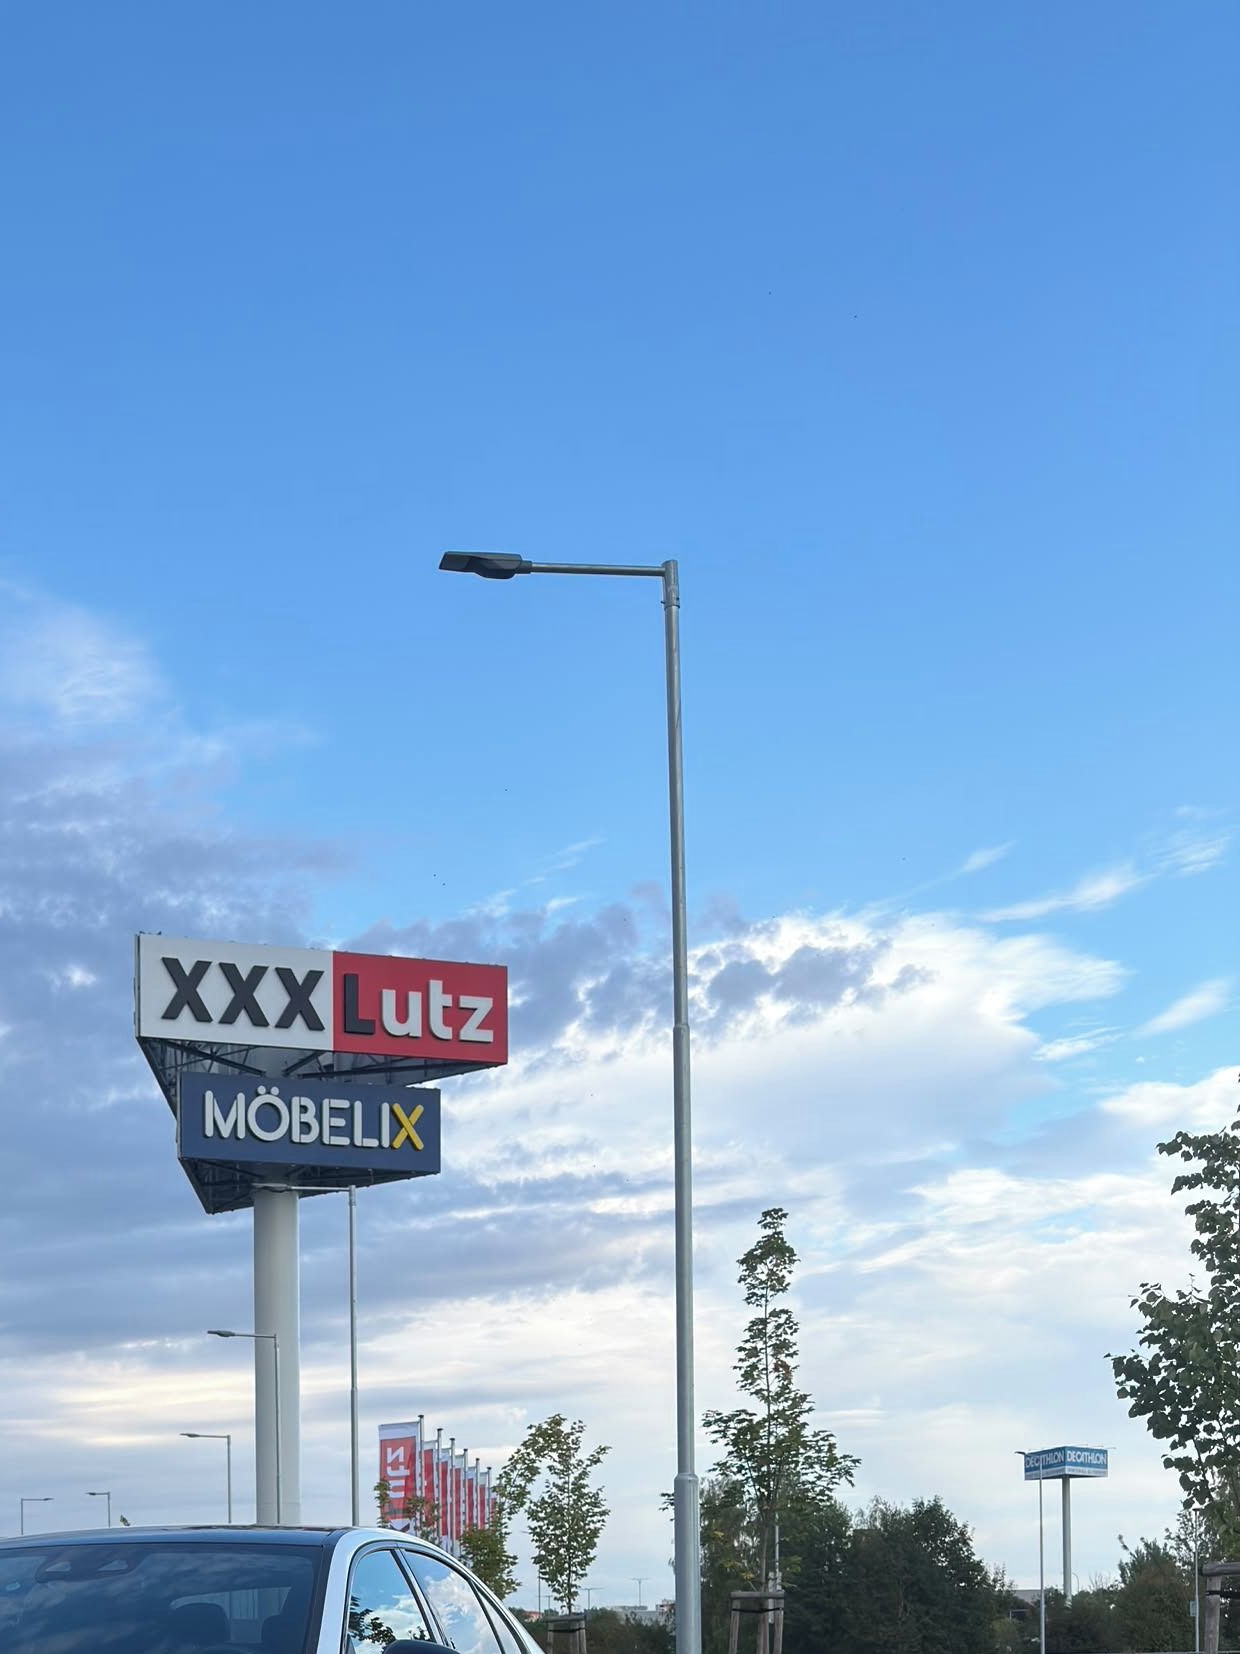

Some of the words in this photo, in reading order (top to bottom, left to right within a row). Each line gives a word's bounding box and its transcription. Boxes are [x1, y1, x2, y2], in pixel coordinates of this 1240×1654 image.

[161, 956, 494, 1043] XXXLutz
[204, 1085, 425, 1150] MÖBELIX
[1066, 1451, 1107, 1464] DECATHLON
